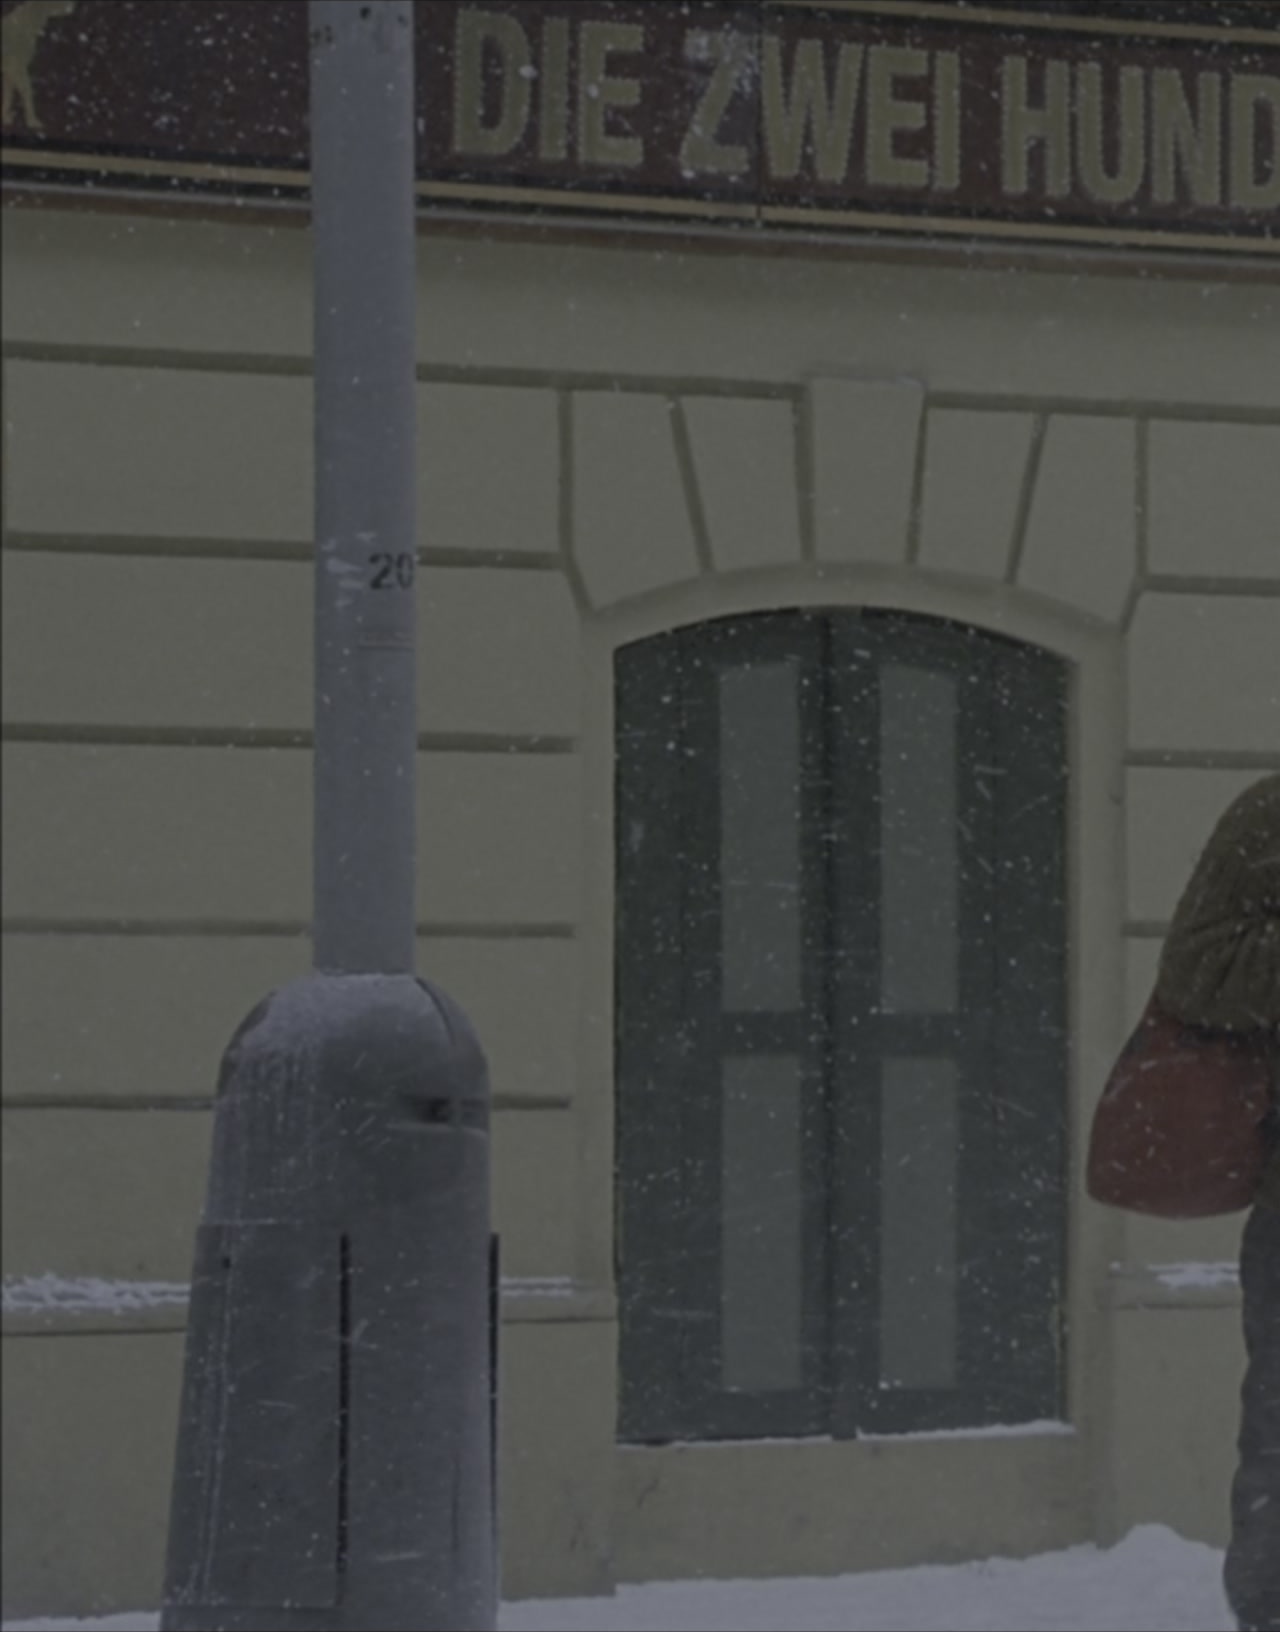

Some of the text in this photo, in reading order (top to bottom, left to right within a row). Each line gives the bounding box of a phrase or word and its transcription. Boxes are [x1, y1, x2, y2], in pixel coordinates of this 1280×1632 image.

[453, 10, 645, 168] DIE
[679, 29, 961, 192] ZWEI
[368, 551, 414, 591] 20
